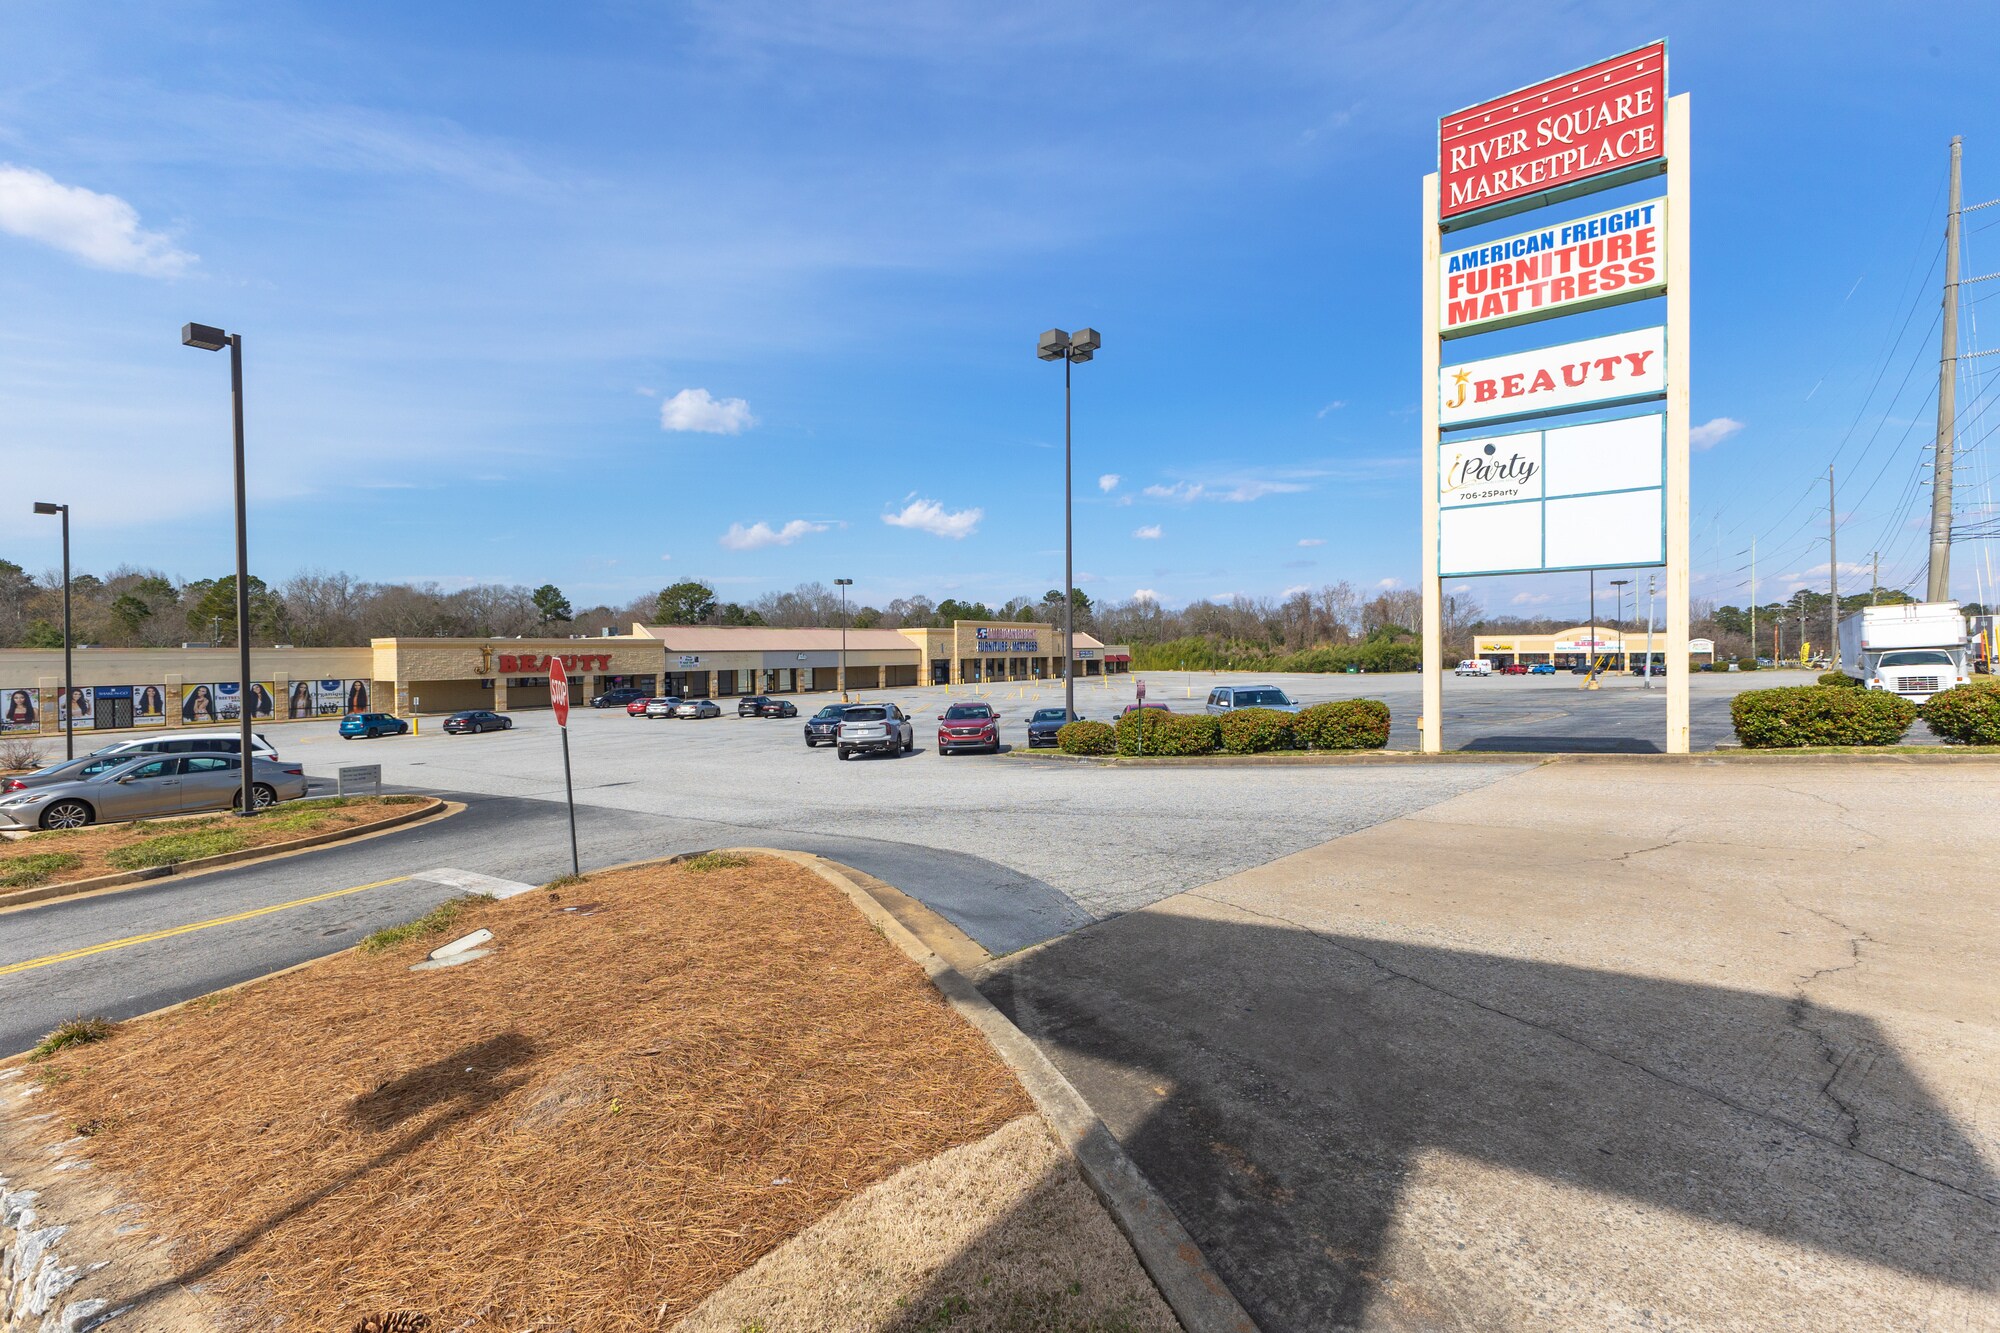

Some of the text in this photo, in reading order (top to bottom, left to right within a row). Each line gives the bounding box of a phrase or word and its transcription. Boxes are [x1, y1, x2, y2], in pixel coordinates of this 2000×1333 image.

[1449, 87, 1655, 174] RIVER SQUARE
[1449, 125, 1656, 208] MARKETPLACE
[1448, 205, 1655, 274] AMERICAN FREIGHT
[1448, 227, 1656, 300] FURNITURE
[1448, 257, 1656, 326] MATTRESS
[1473, 350, 1654, 404] BEAUTY
[1460, 487, 1519, 501] 706-25Party
[498, 654, 612, 674] BEAUTY
[551, 679, 567, 706] STOP
[1462, 661, 1478, 669] FedEx
